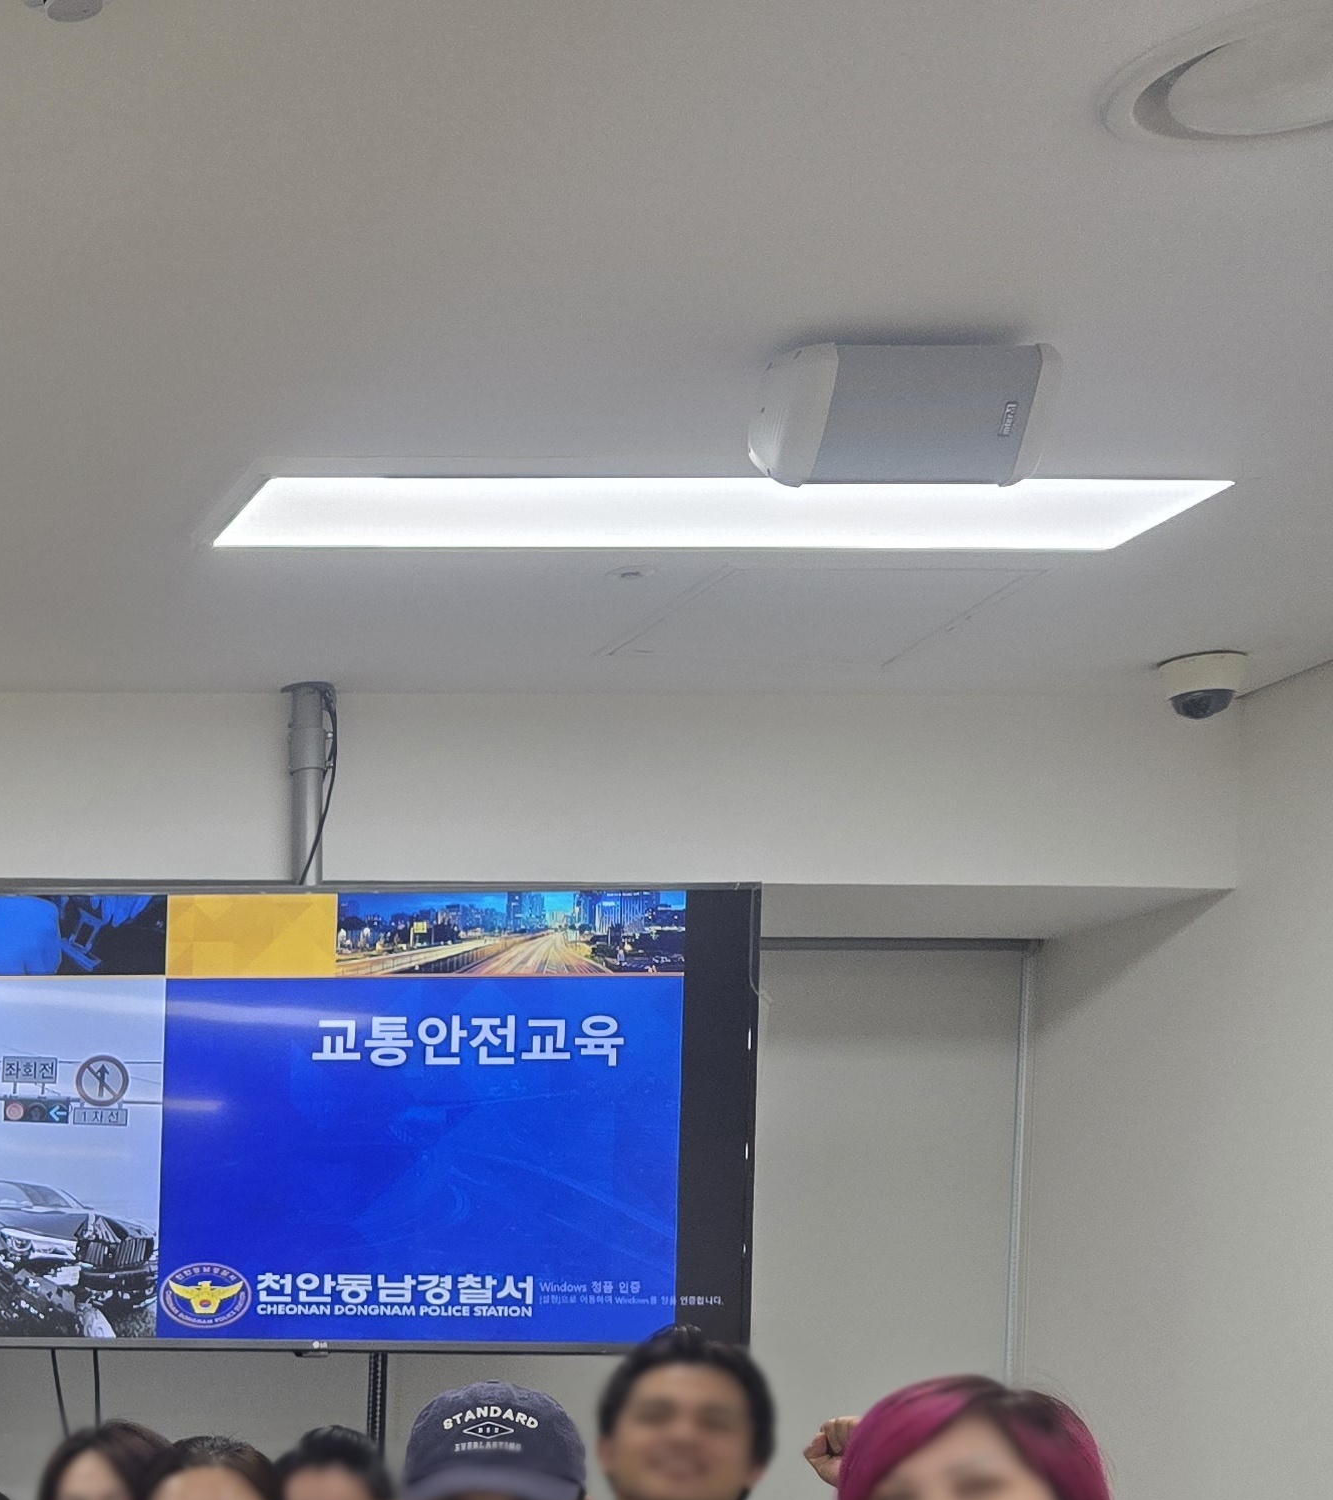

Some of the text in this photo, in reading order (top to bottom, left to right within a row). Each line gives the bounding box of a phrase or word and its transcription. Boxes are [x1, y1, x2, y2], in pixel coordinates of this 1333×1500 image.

[312, 1015, 625, 1067] 교통안전교육
[5, 1061, 54, 1079] 좌회전
[256, 1273, 534, 1304] 천안동남경찰서
[539, 1281, 641, 1293] Windows 정품 인증
[256, 1304, 533, 1317] CHEONAN DONGNAM POLICE STATION
[443, 1406, 538, 1429] STANDARD
